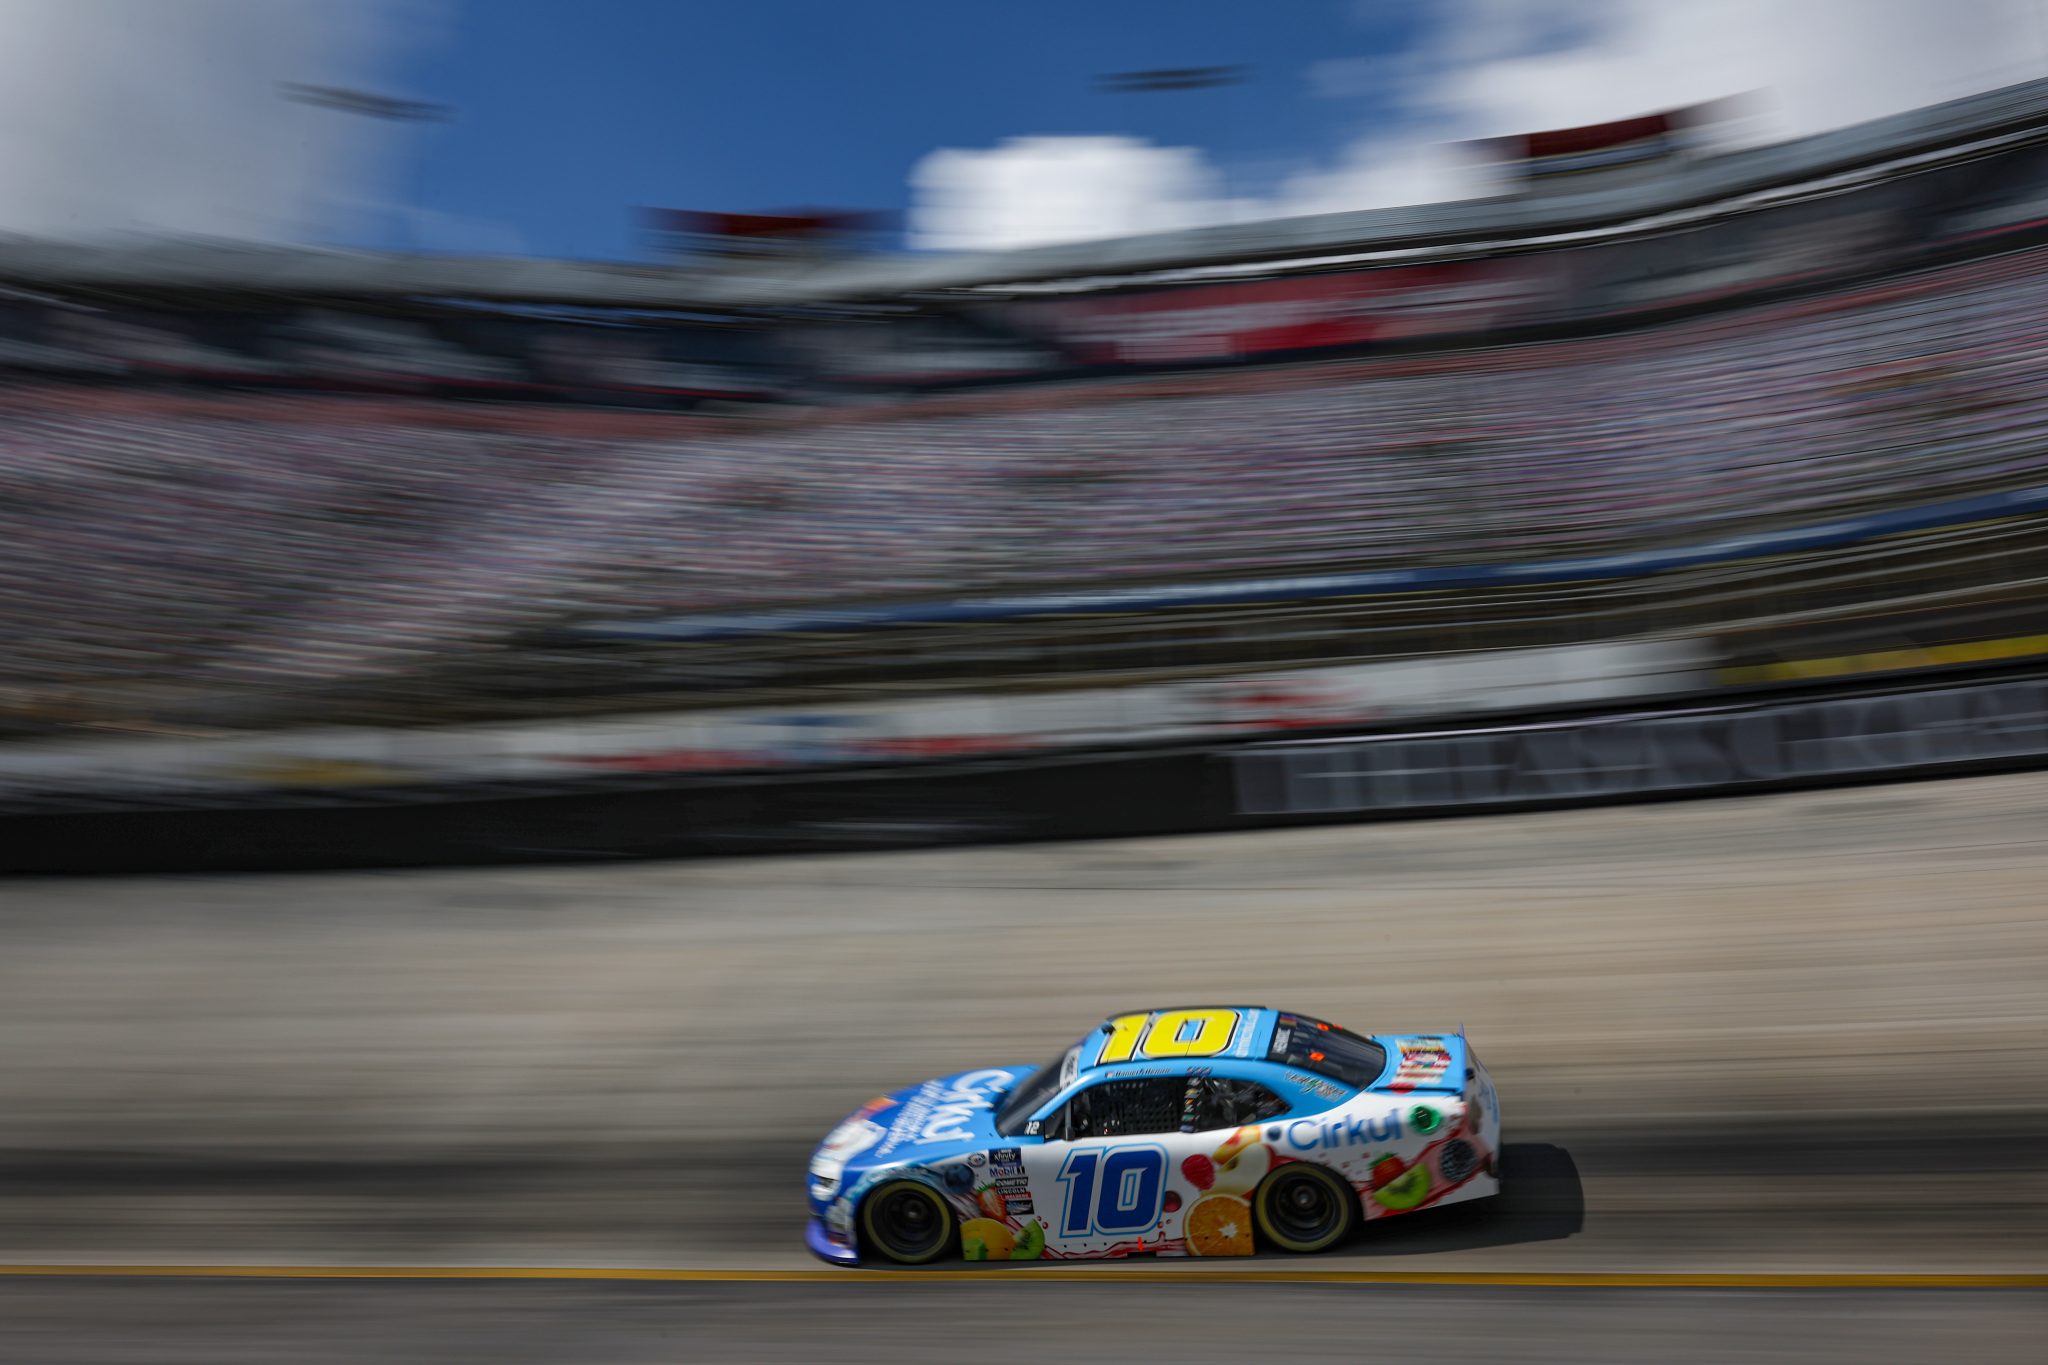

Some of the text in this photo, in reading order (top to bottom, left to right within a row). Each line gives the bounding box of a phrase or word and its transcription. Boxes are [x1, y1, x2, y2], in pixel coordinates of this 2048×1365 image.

[1096, 1009, 1241, 1065] 10
[1288, 1109, 1403, 1151] Cirkul
[989, 1166, 1016, 1178] Mobil
[1057, 1143, 1169, 1238] 10
